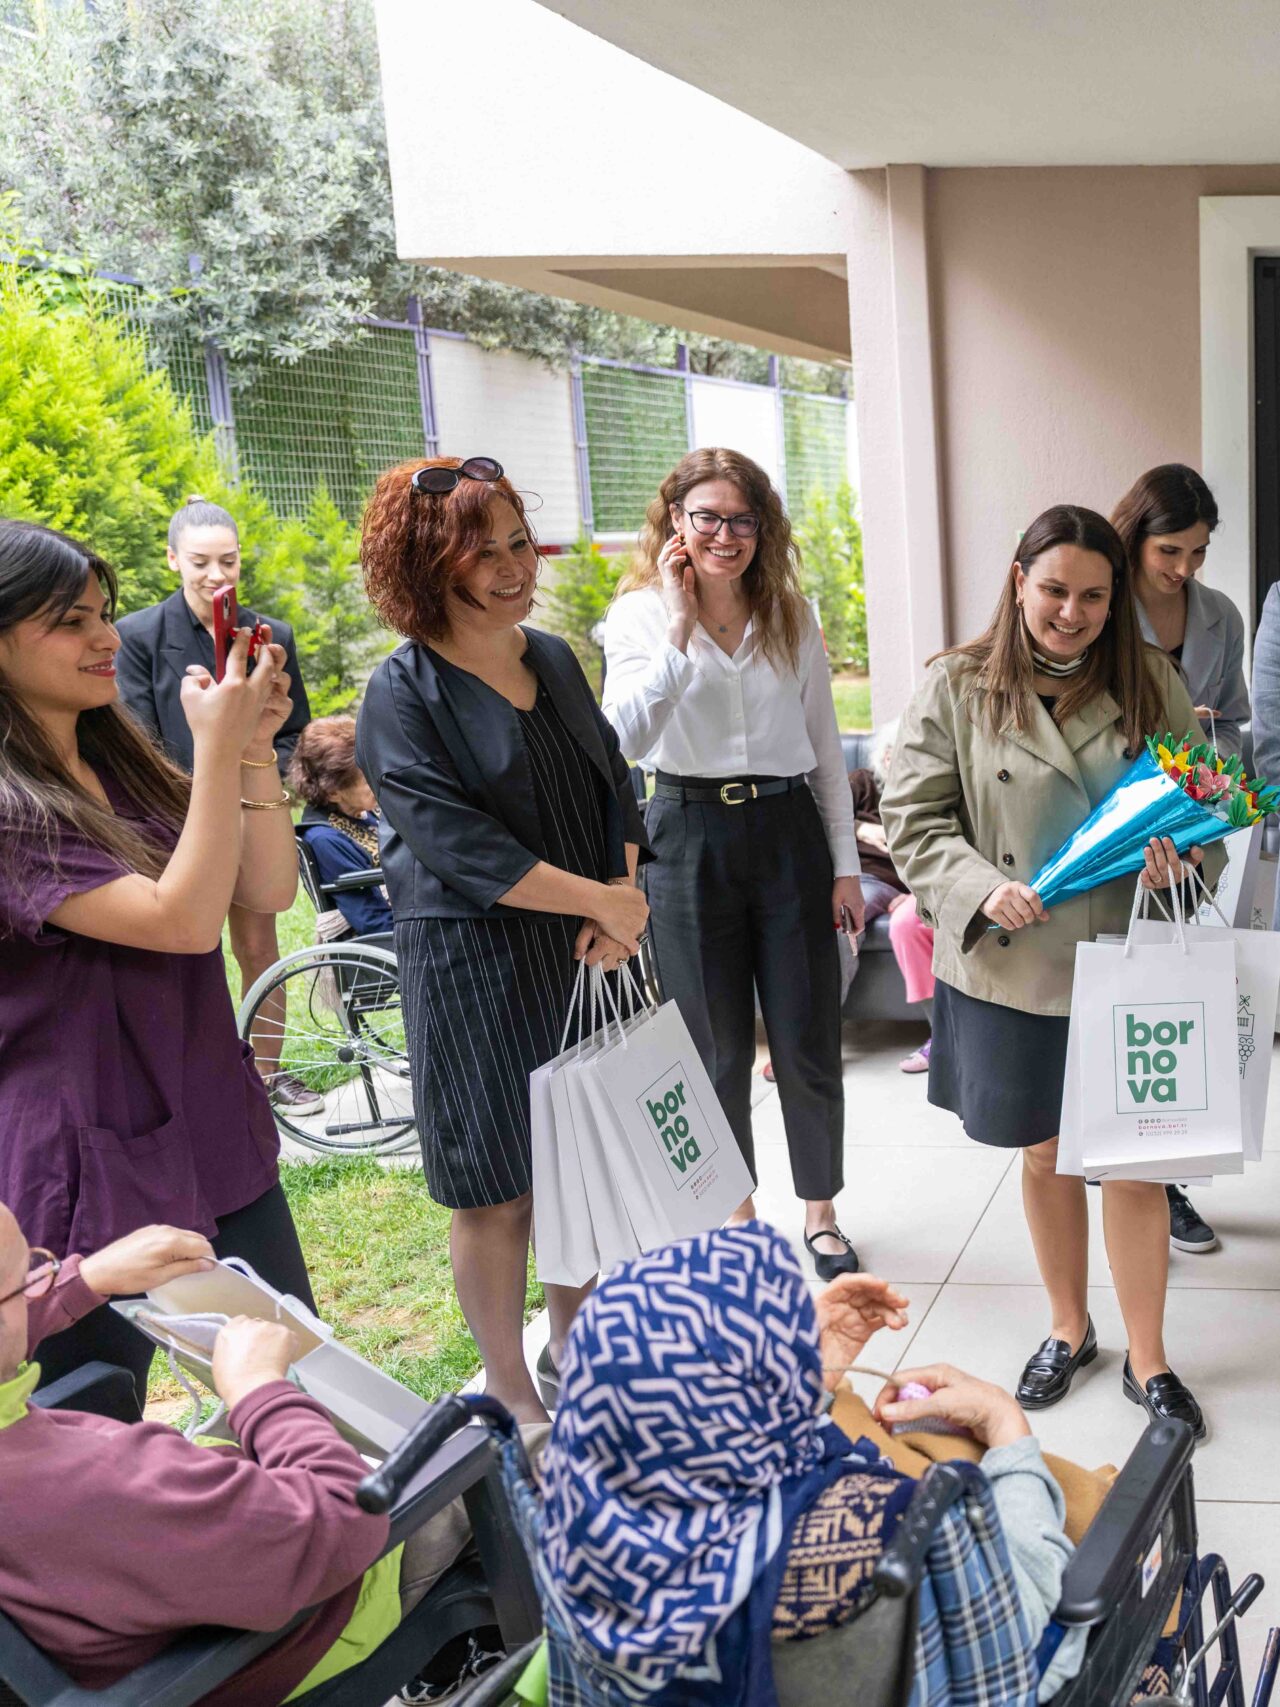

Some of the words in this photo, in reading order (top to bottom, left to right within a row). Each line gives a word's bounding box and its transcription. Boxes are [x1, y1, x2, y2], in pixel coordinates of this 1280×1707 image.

[1126, 1013, 1194, 1047] bor
[1127, 1049, 1177, 1075] no
[646, 1080, 687, 1130] bor
[1127, 1077, 1177, 1103] va
[661, 1114, 689, 1153] no
[670, 1136, 701, 1173] va
